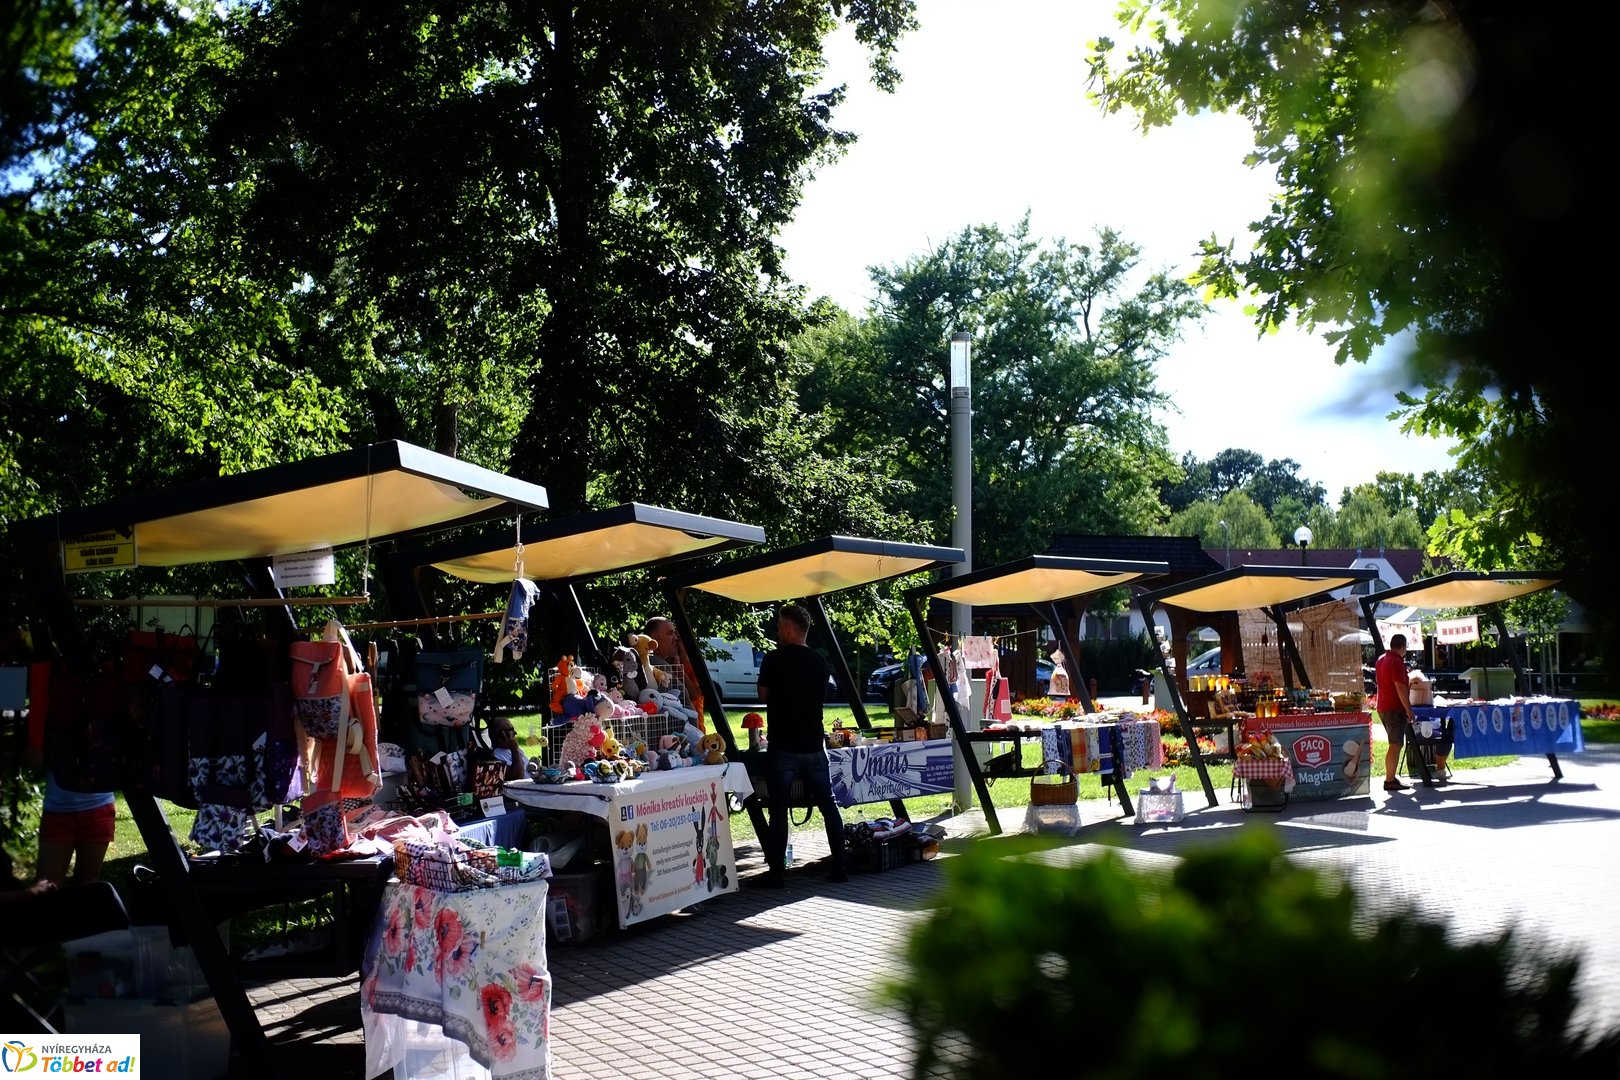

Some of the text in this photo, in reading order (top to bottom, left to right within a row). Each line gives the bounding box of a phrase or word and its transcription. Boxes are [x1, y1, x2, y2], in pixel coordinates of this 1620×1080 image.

[1259, 717, 1358, 729] A természet kincsei ételünk részei!
[1300, 740, 1325, 752] PACO
[851, 746, 909, 783] Omnis
[1298, 768, 1335, 787] Magtár
[868, 780, 912, 797] Alapítvány
[636, 799, 661, 817] Mónika
[661, 795, 685, 814] kreatív
[685, 790, 708, 808] kuckója
[650, 821, 660, 832] Tel:
